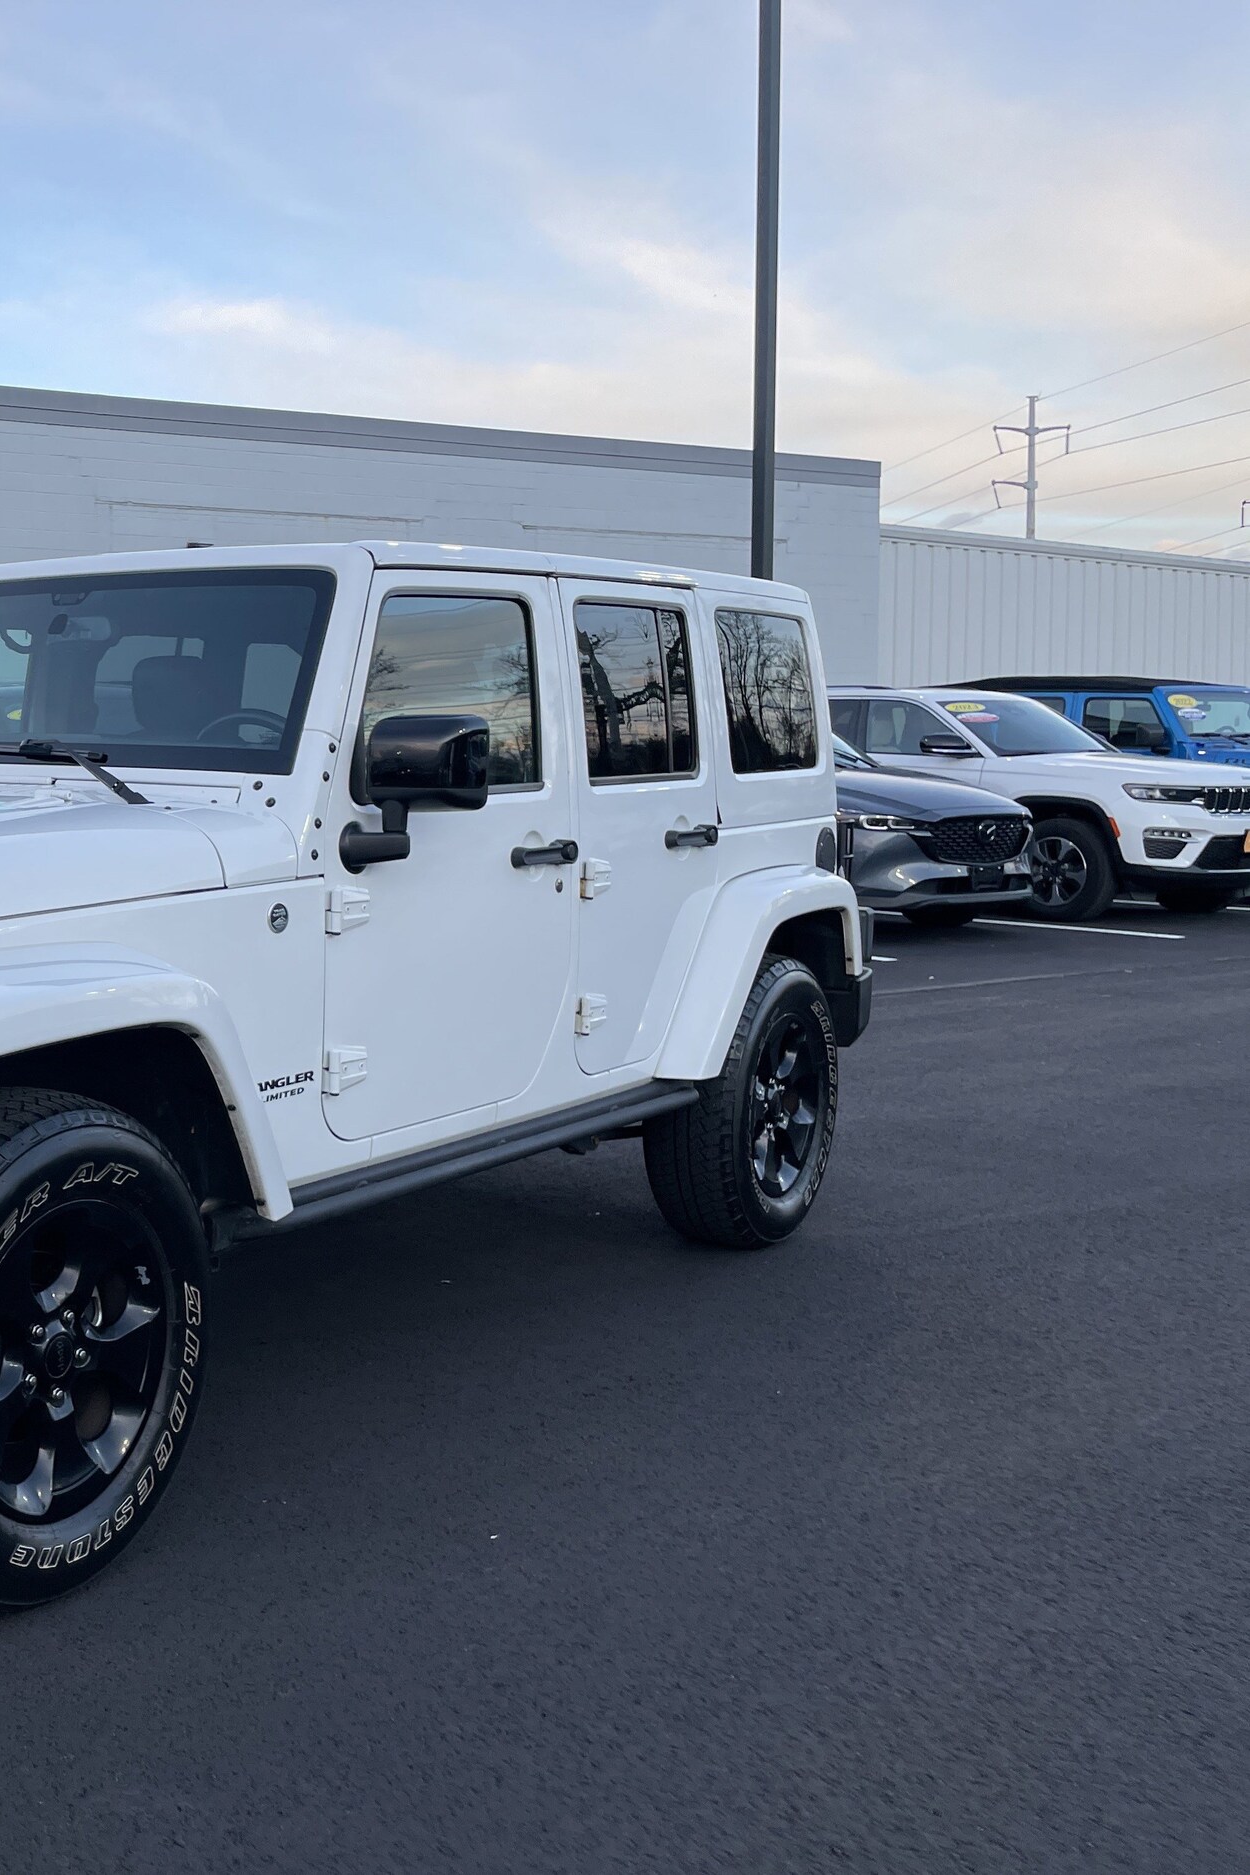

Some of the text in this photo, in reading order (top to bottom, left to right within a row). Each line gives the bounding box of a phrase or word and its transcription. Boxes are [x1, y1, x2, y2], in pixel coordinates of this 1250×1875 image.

[263, 1087, 305, 1103] IMITED
[63, 1161, 140, 1190] A/T
[9, 1281, 201, 1569] BRIDGESTONE
